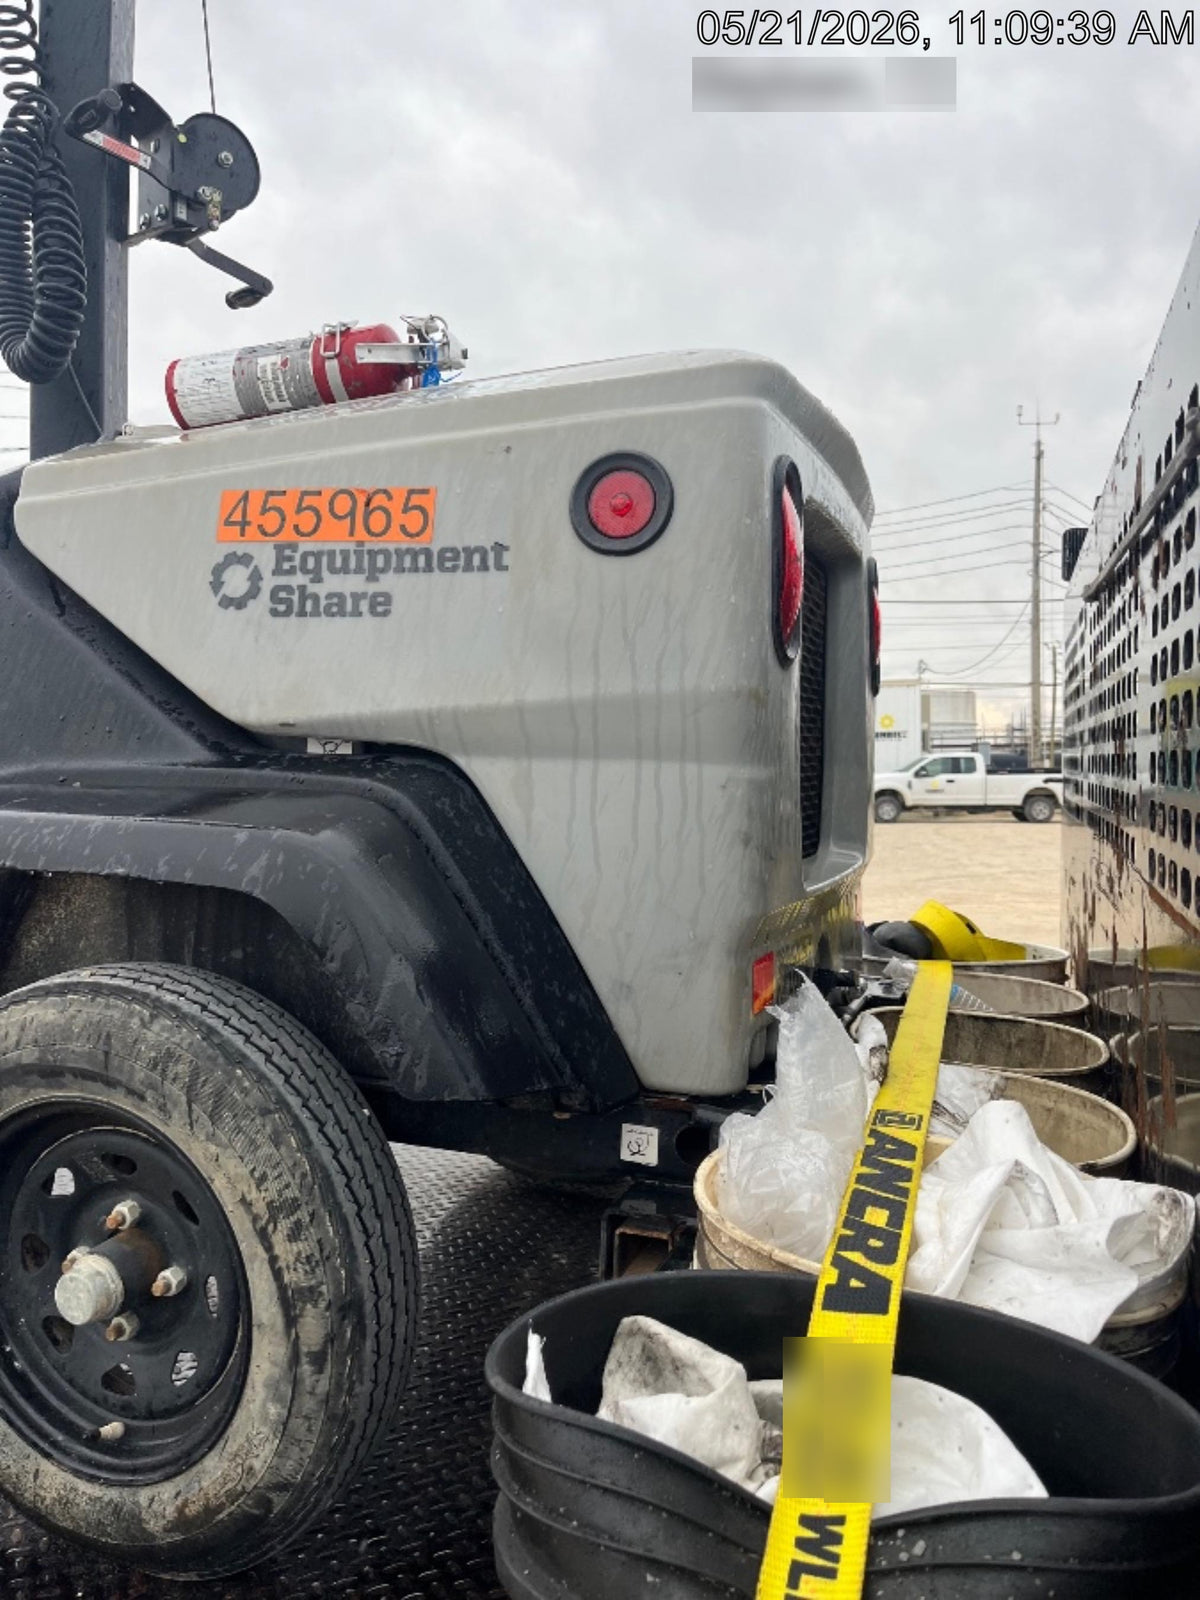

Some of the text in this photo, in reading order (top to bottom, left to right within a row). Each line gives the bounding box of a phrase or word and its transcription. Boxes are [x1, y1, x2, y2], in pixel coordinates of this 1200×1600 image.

[222, 487, 431, 539] 455965
[271, 541, 510, 583] Equipment
[268, 583, 393, 618] Share
[821, 1127, 918, 1315] ANCRA
[783, 1512, 847, 1600] WL
